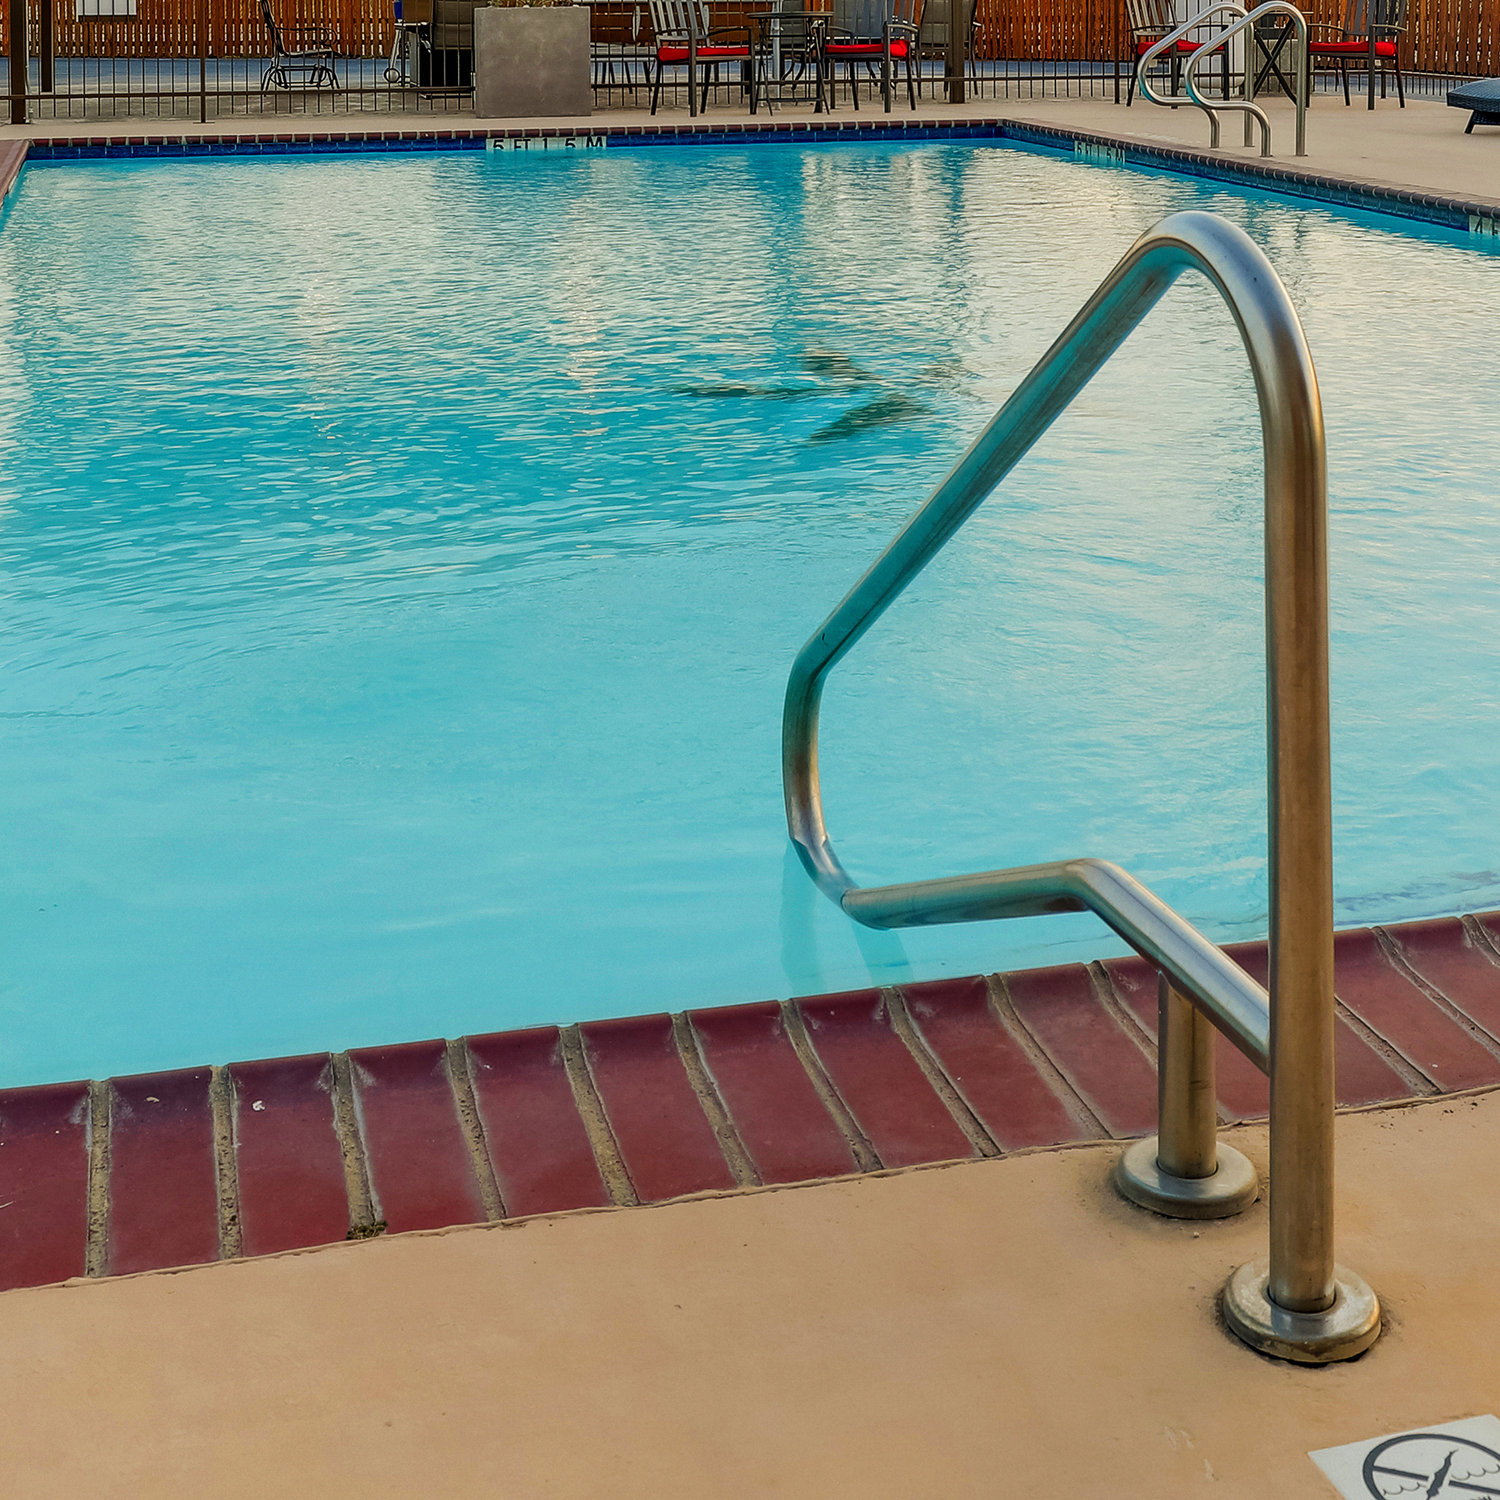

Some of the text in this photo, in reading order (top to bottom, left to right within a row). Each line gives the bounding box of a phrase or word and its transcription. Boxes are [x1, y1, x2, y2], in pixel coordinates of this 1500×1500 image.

[493, 138, 504, 150] 5
[514, 138, 531, 150] FT
[586, 136, 603, 148] M
